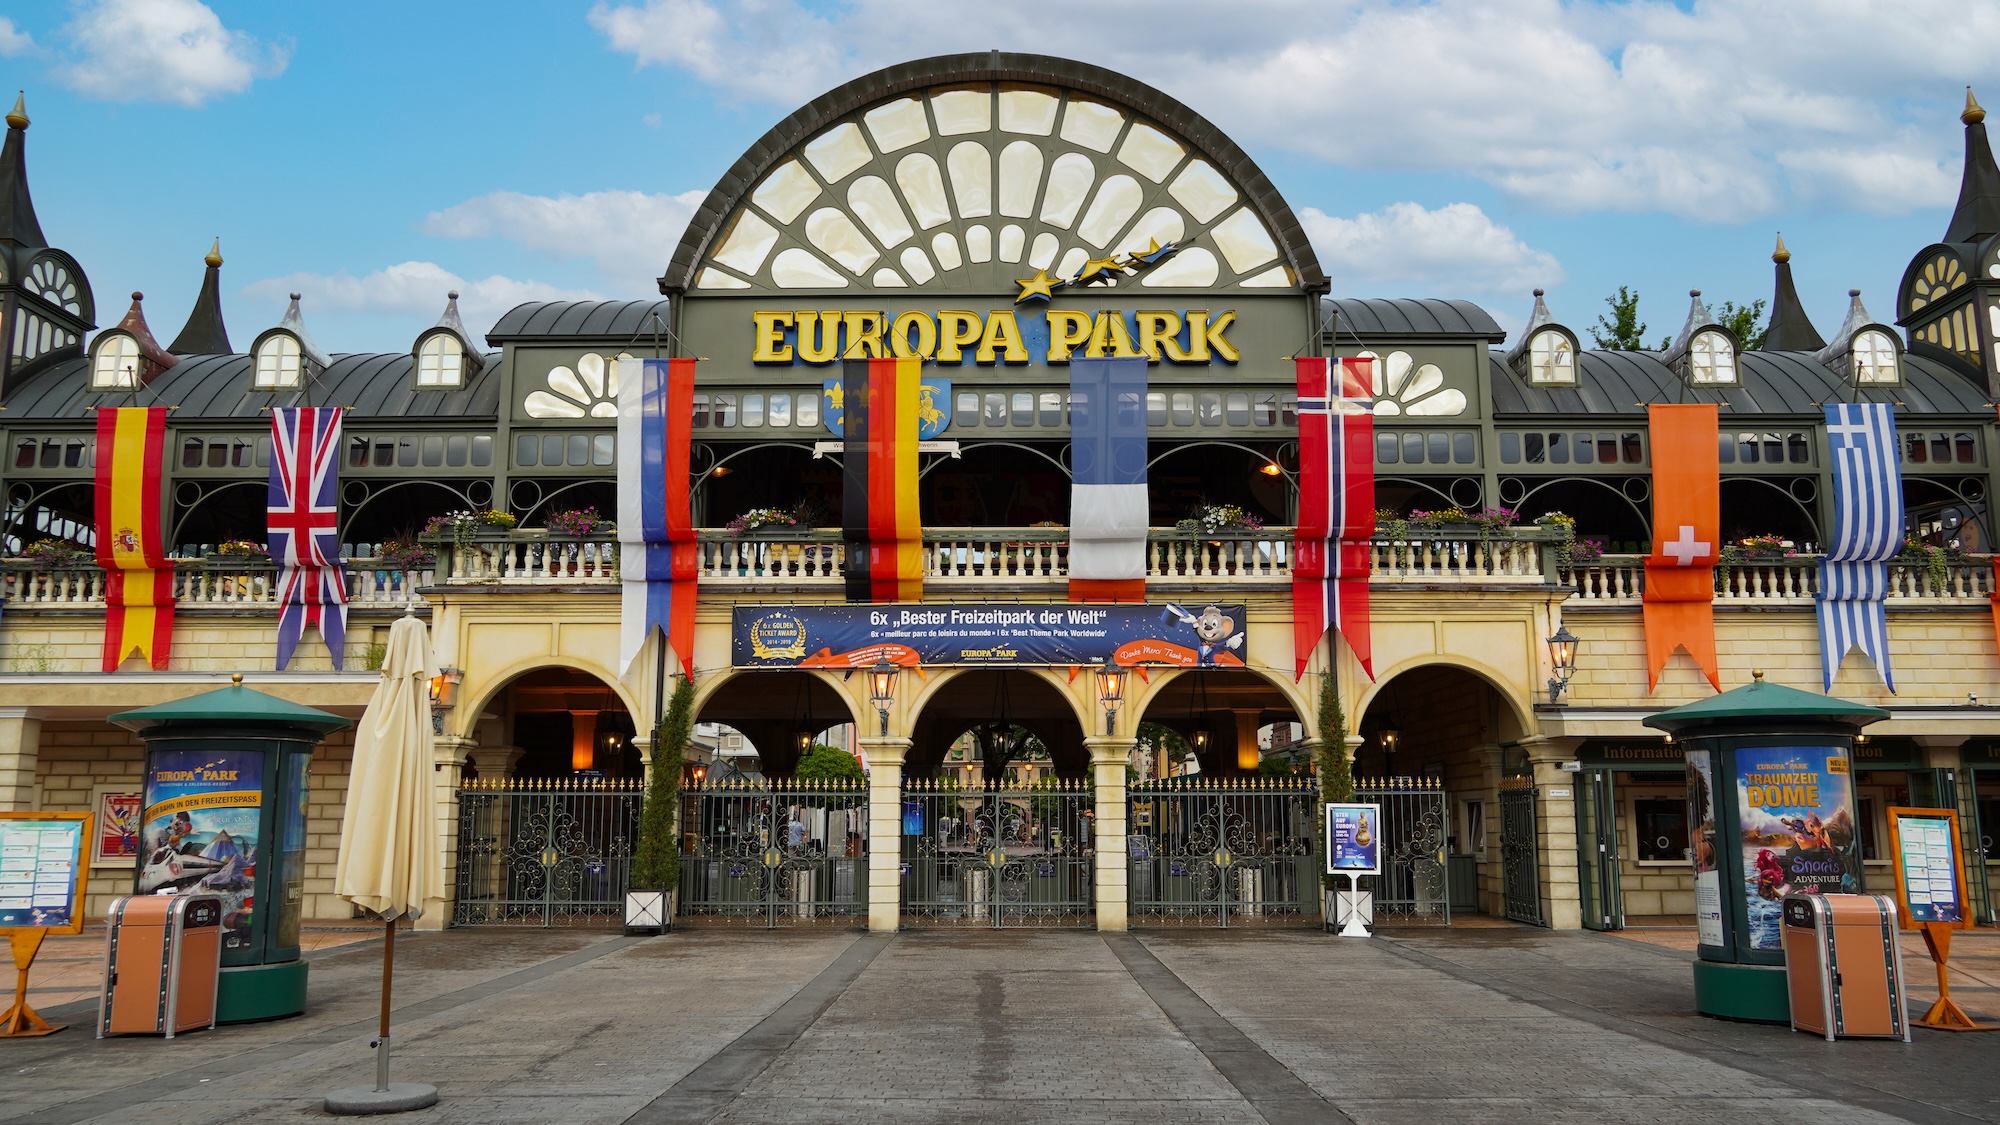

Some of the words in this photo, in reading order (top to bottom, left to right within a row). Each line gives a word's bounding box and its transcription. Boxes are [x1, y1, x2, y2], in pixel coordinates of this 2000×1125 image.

[752, 310, 1029, 364] EUROPA
[1046, 309, 1240, 365] PARK
[870, 611, 888, 625] 6x
[951, 609, 1036, 627] Freizeitpark
[1040, 610, 1064, 625] der
[870, 630, 879, 638] 6x
[912, 630, 927, 638] parc
[938, 629, 958, 637] loisirs
[960, 629, 968, 637] du
[1029, 629, 1052, 637] Theme
[1053, 629, 1069, 637] Park
[1120, 649, 1141, 660] Danke
[1164, 647, 1182, 660] Thank
[156, 771, 196, 782] EUROPA
[202, 770, 239, 781] PARK
[1747, 773, 1818, 785] TRAUMZEIT
[1747, 785, 1821, 807] DOME
[160, 803, 175, 813] BAHN
[185, 798, 199, 807] DEN
[201, 795, 257, 805] FREIZEITSPASS
[1793, 875, 1840, 883] ADVENTURE
